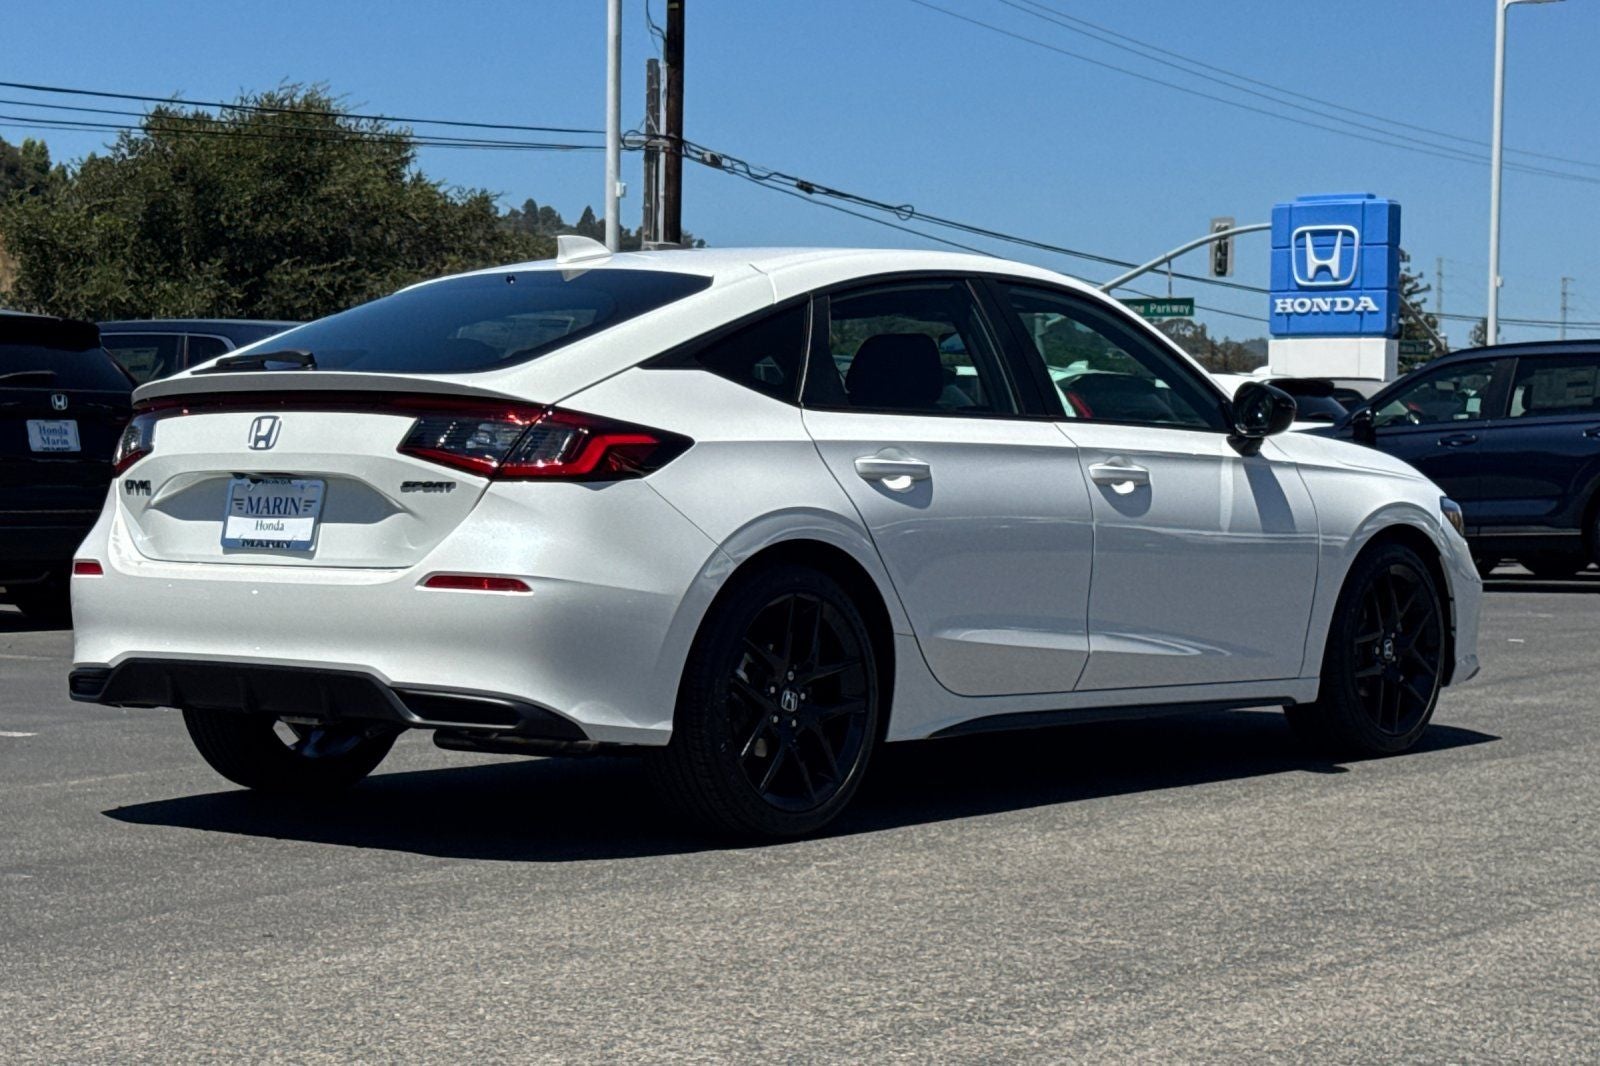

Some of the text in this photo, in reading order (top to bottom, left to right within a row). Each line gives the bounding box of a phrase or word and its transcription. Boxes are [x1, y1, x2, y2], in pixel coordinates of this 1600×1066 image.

[1149, 303, 1191, 315] Parkway
[1274, 296, 1380, 313] HONDA
[38, 425, 68, 435] Honda
[41, 435, 69, 445] Marin
[246, 496, 303, 515] MARIN
[255, 519, 285, 531] Honda
[241, 538, 292, 549] MARIN
